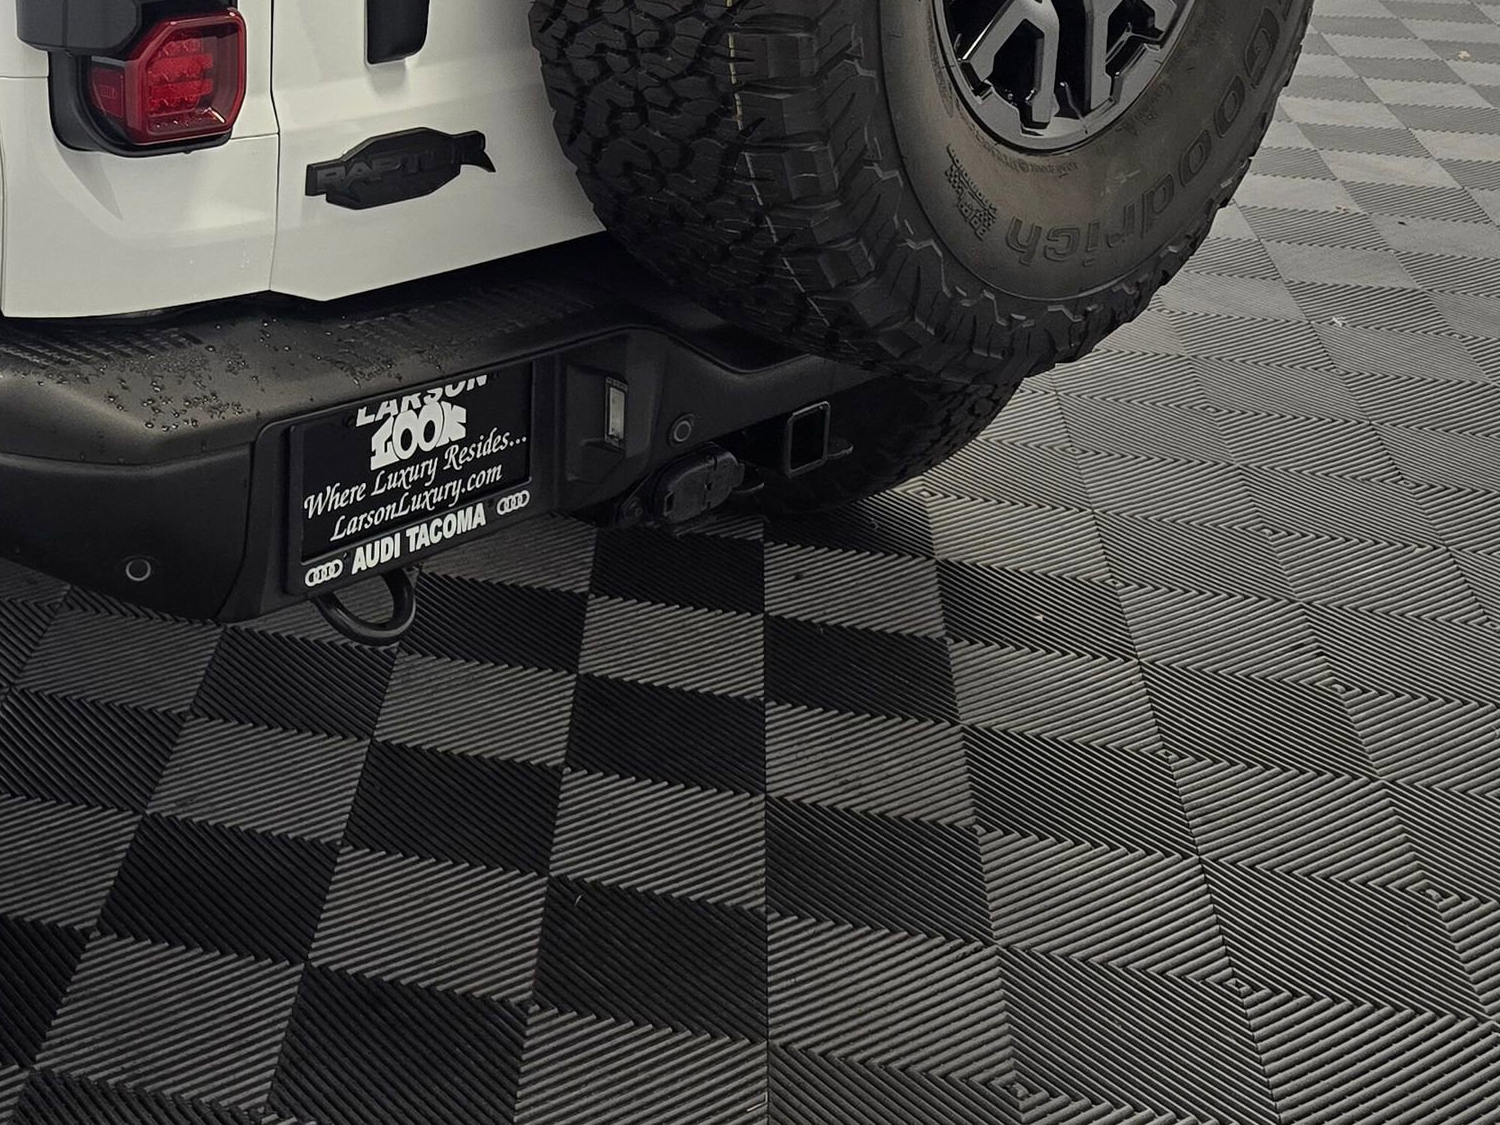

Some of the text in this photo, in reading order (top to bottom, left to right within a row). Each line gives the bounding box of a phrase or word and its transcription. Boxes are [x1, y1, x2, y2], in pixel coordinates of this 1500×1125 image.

[304, 427, 527, 519] Where Luxury Resides...
[330, 464, 502, 542] LarsonLuxury.com
[351, 502, 487, 575] AUDI TACOMA
